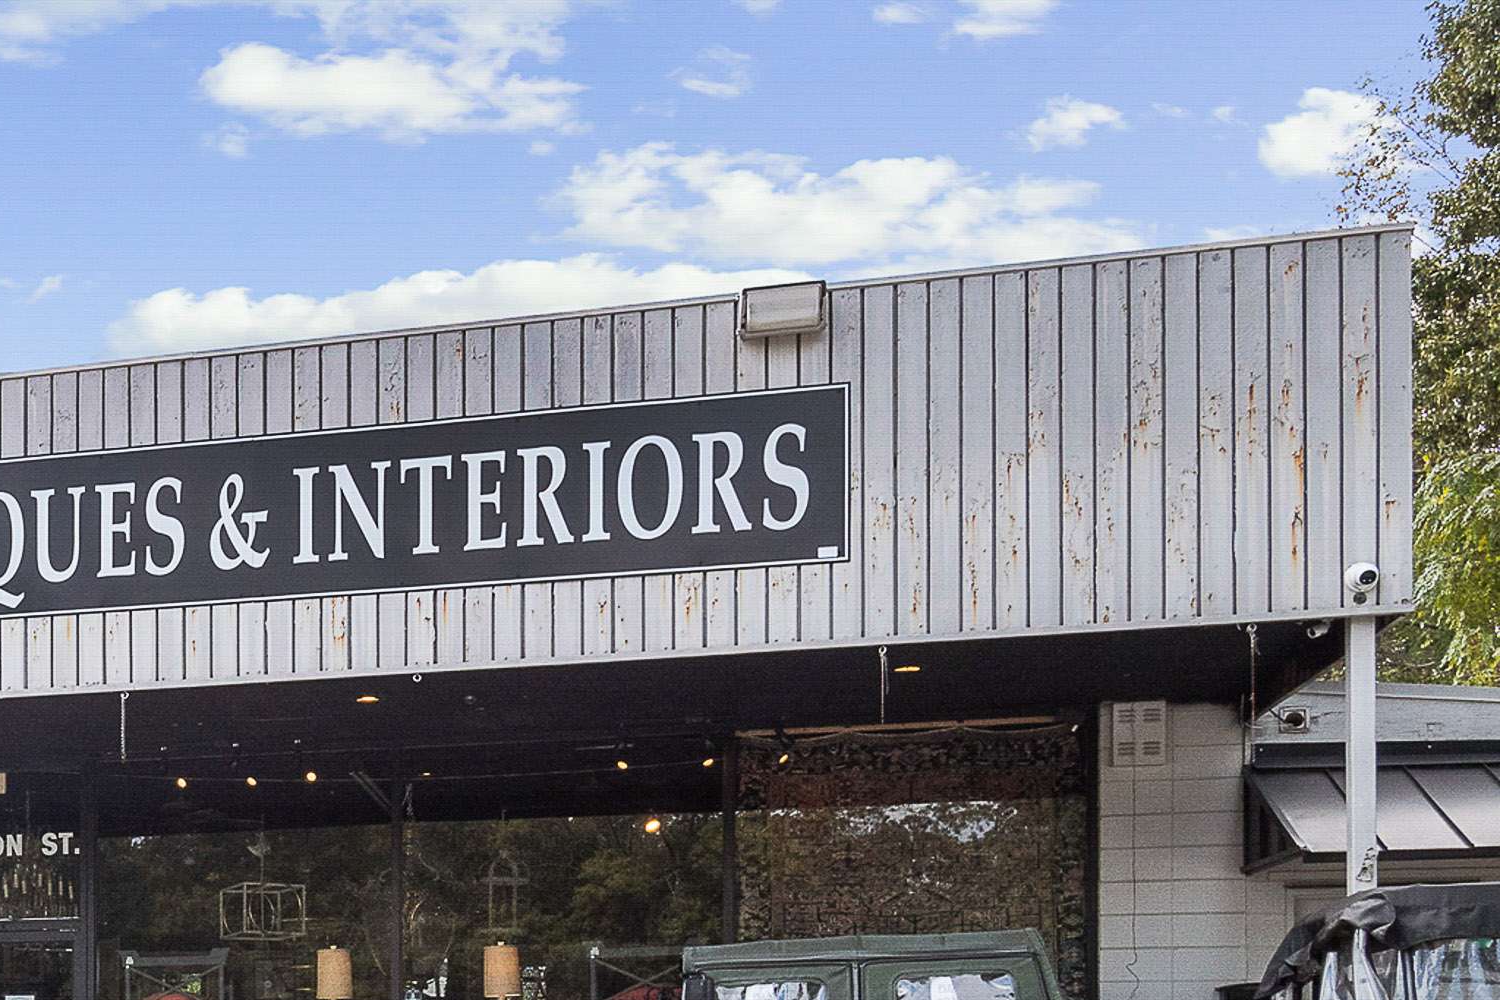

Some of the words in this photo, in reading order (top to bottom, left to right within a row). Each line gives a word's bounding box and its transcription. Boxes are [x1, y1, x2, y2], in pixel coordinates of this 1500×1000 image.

[209, 473, 271, 571] &
[292, 423, 810, 564] INTERIORS
[41, 832, 81, 856] ST.
